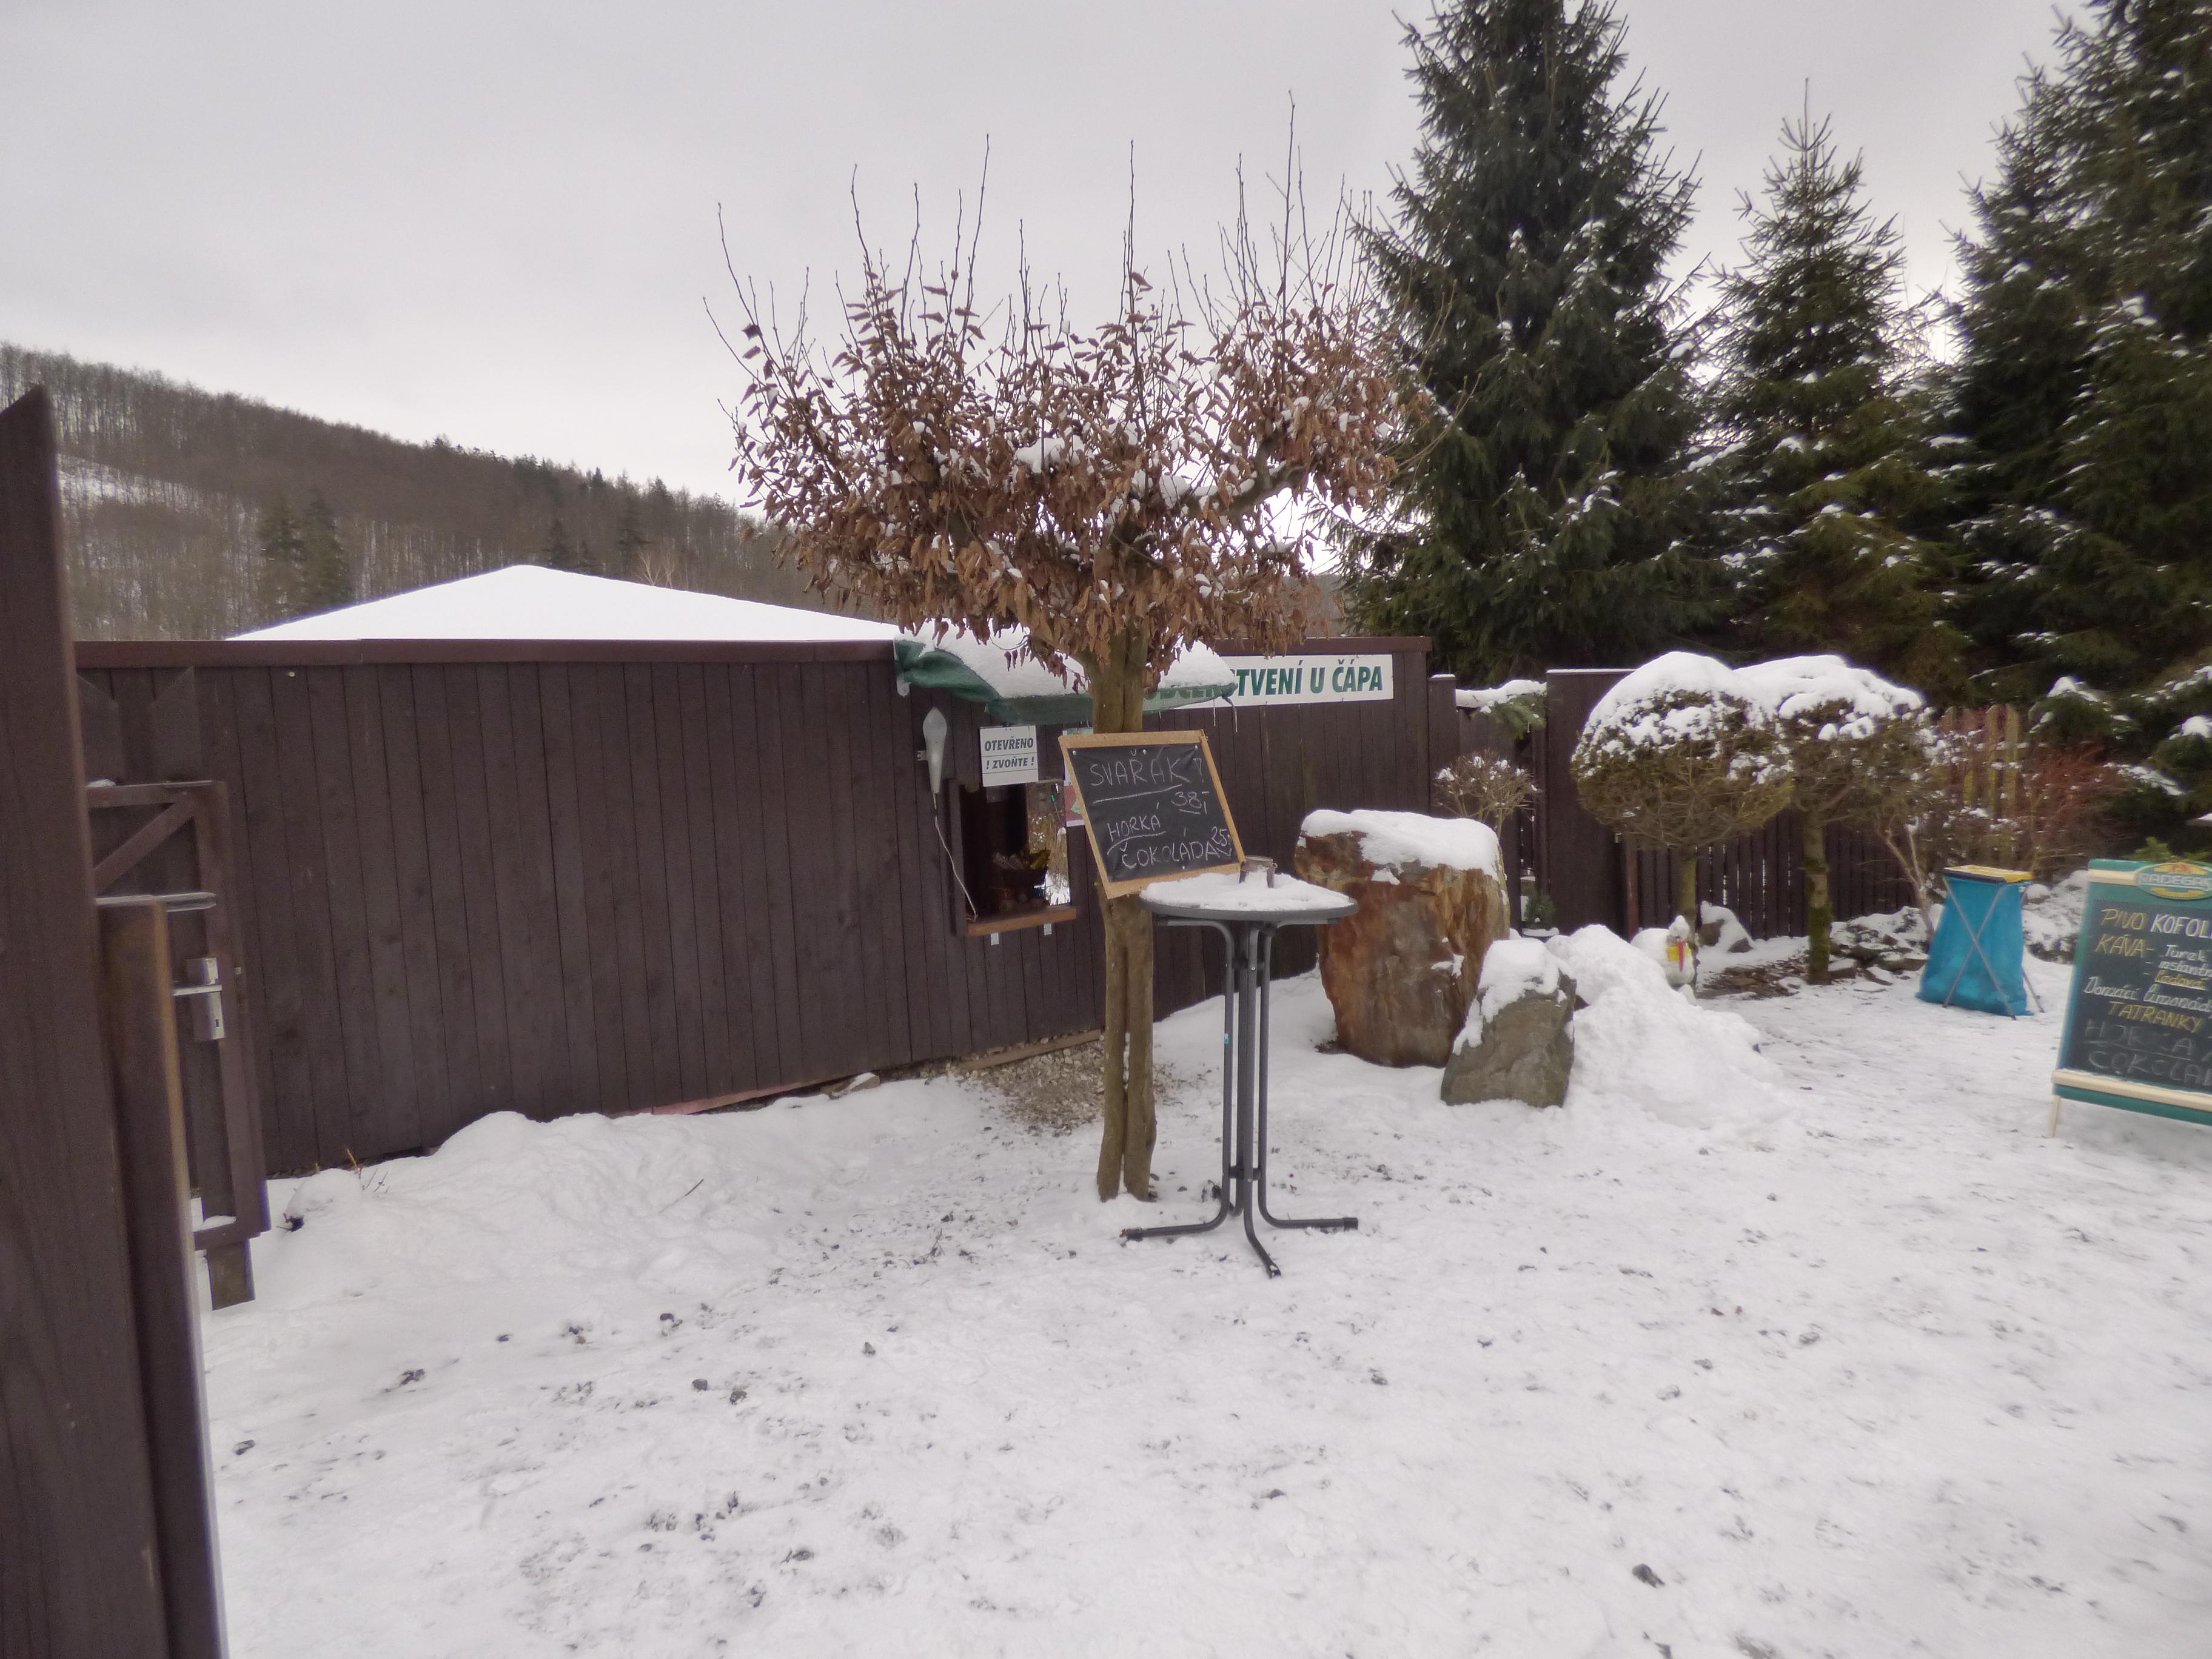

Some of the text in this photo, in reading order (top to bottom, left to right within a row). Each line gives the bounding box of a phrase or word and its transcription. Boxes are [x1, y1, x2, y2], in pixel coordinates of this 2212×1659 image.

[1230, 659, 1382, 696] TVENÍ U ČÁPA
[984, 736, 1034, 751] OTEVŘENO
[992, 756, 1028, 769] ZVOŇTE
[1107, 802, 1161, 842] HORKÁ
[1120, 827, 1220, 869] ČOKOLÁDA
[2100, 908, 2212, 939] PIVO KOFOL
[2165, 945, 2207, 962] Turek
[2108, 1001, 2204, 1032] TATRANKY
